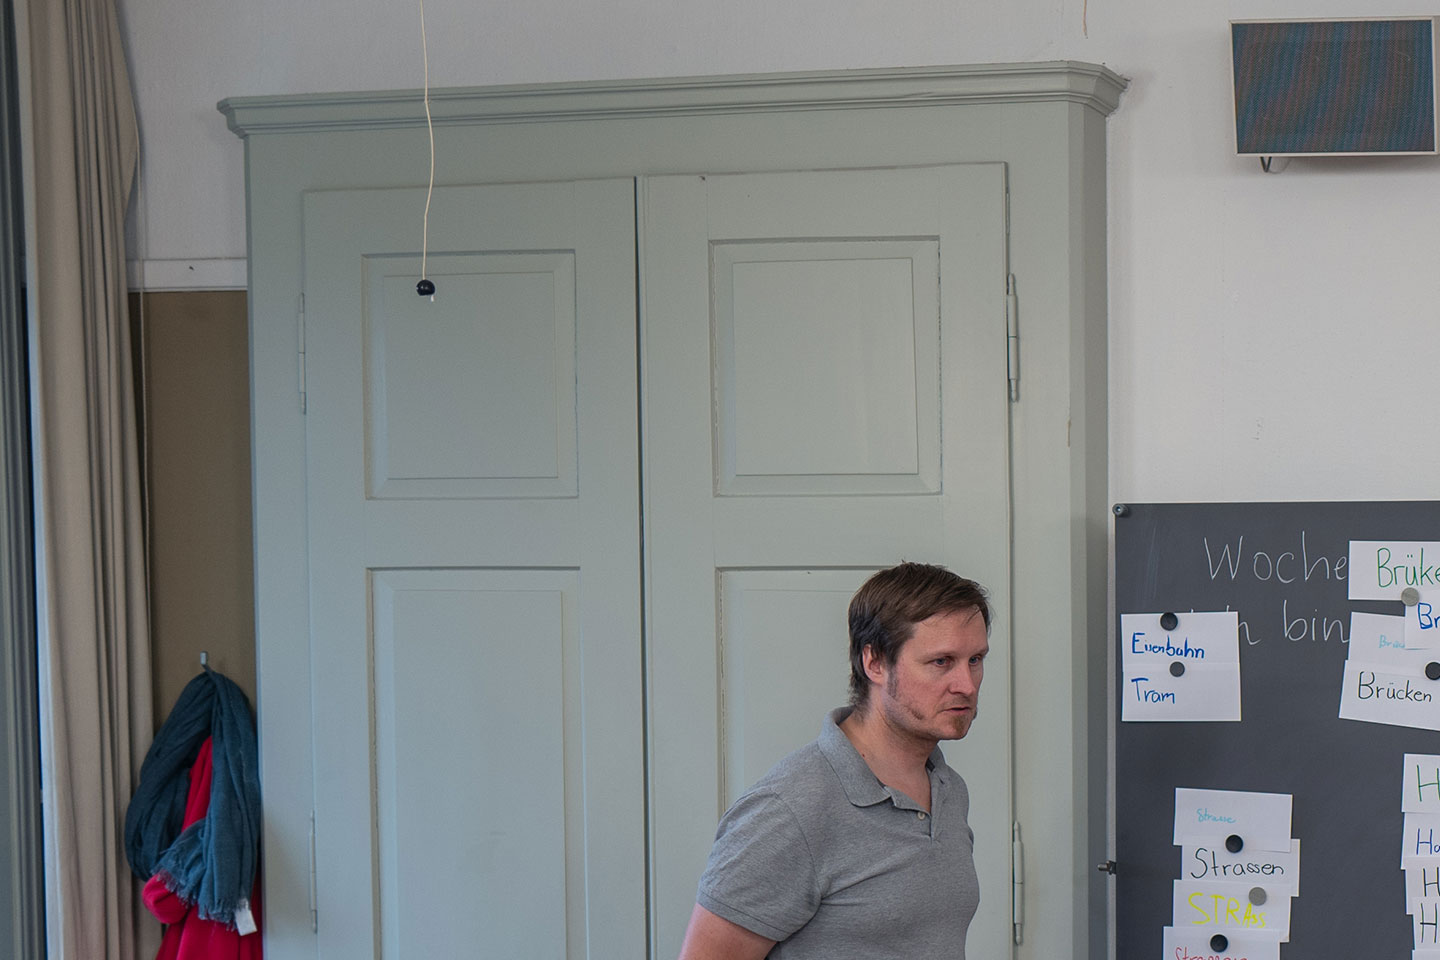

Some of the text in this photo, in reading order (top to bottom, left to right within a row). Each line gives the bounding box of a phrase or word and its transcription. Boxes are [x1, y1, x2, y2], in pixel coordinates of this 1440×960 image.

[1131, 677, 1175, 704] Tram
[1358, 671, 1432, 702] Brücken
[1190, 847, 1284, 879] Strassen
